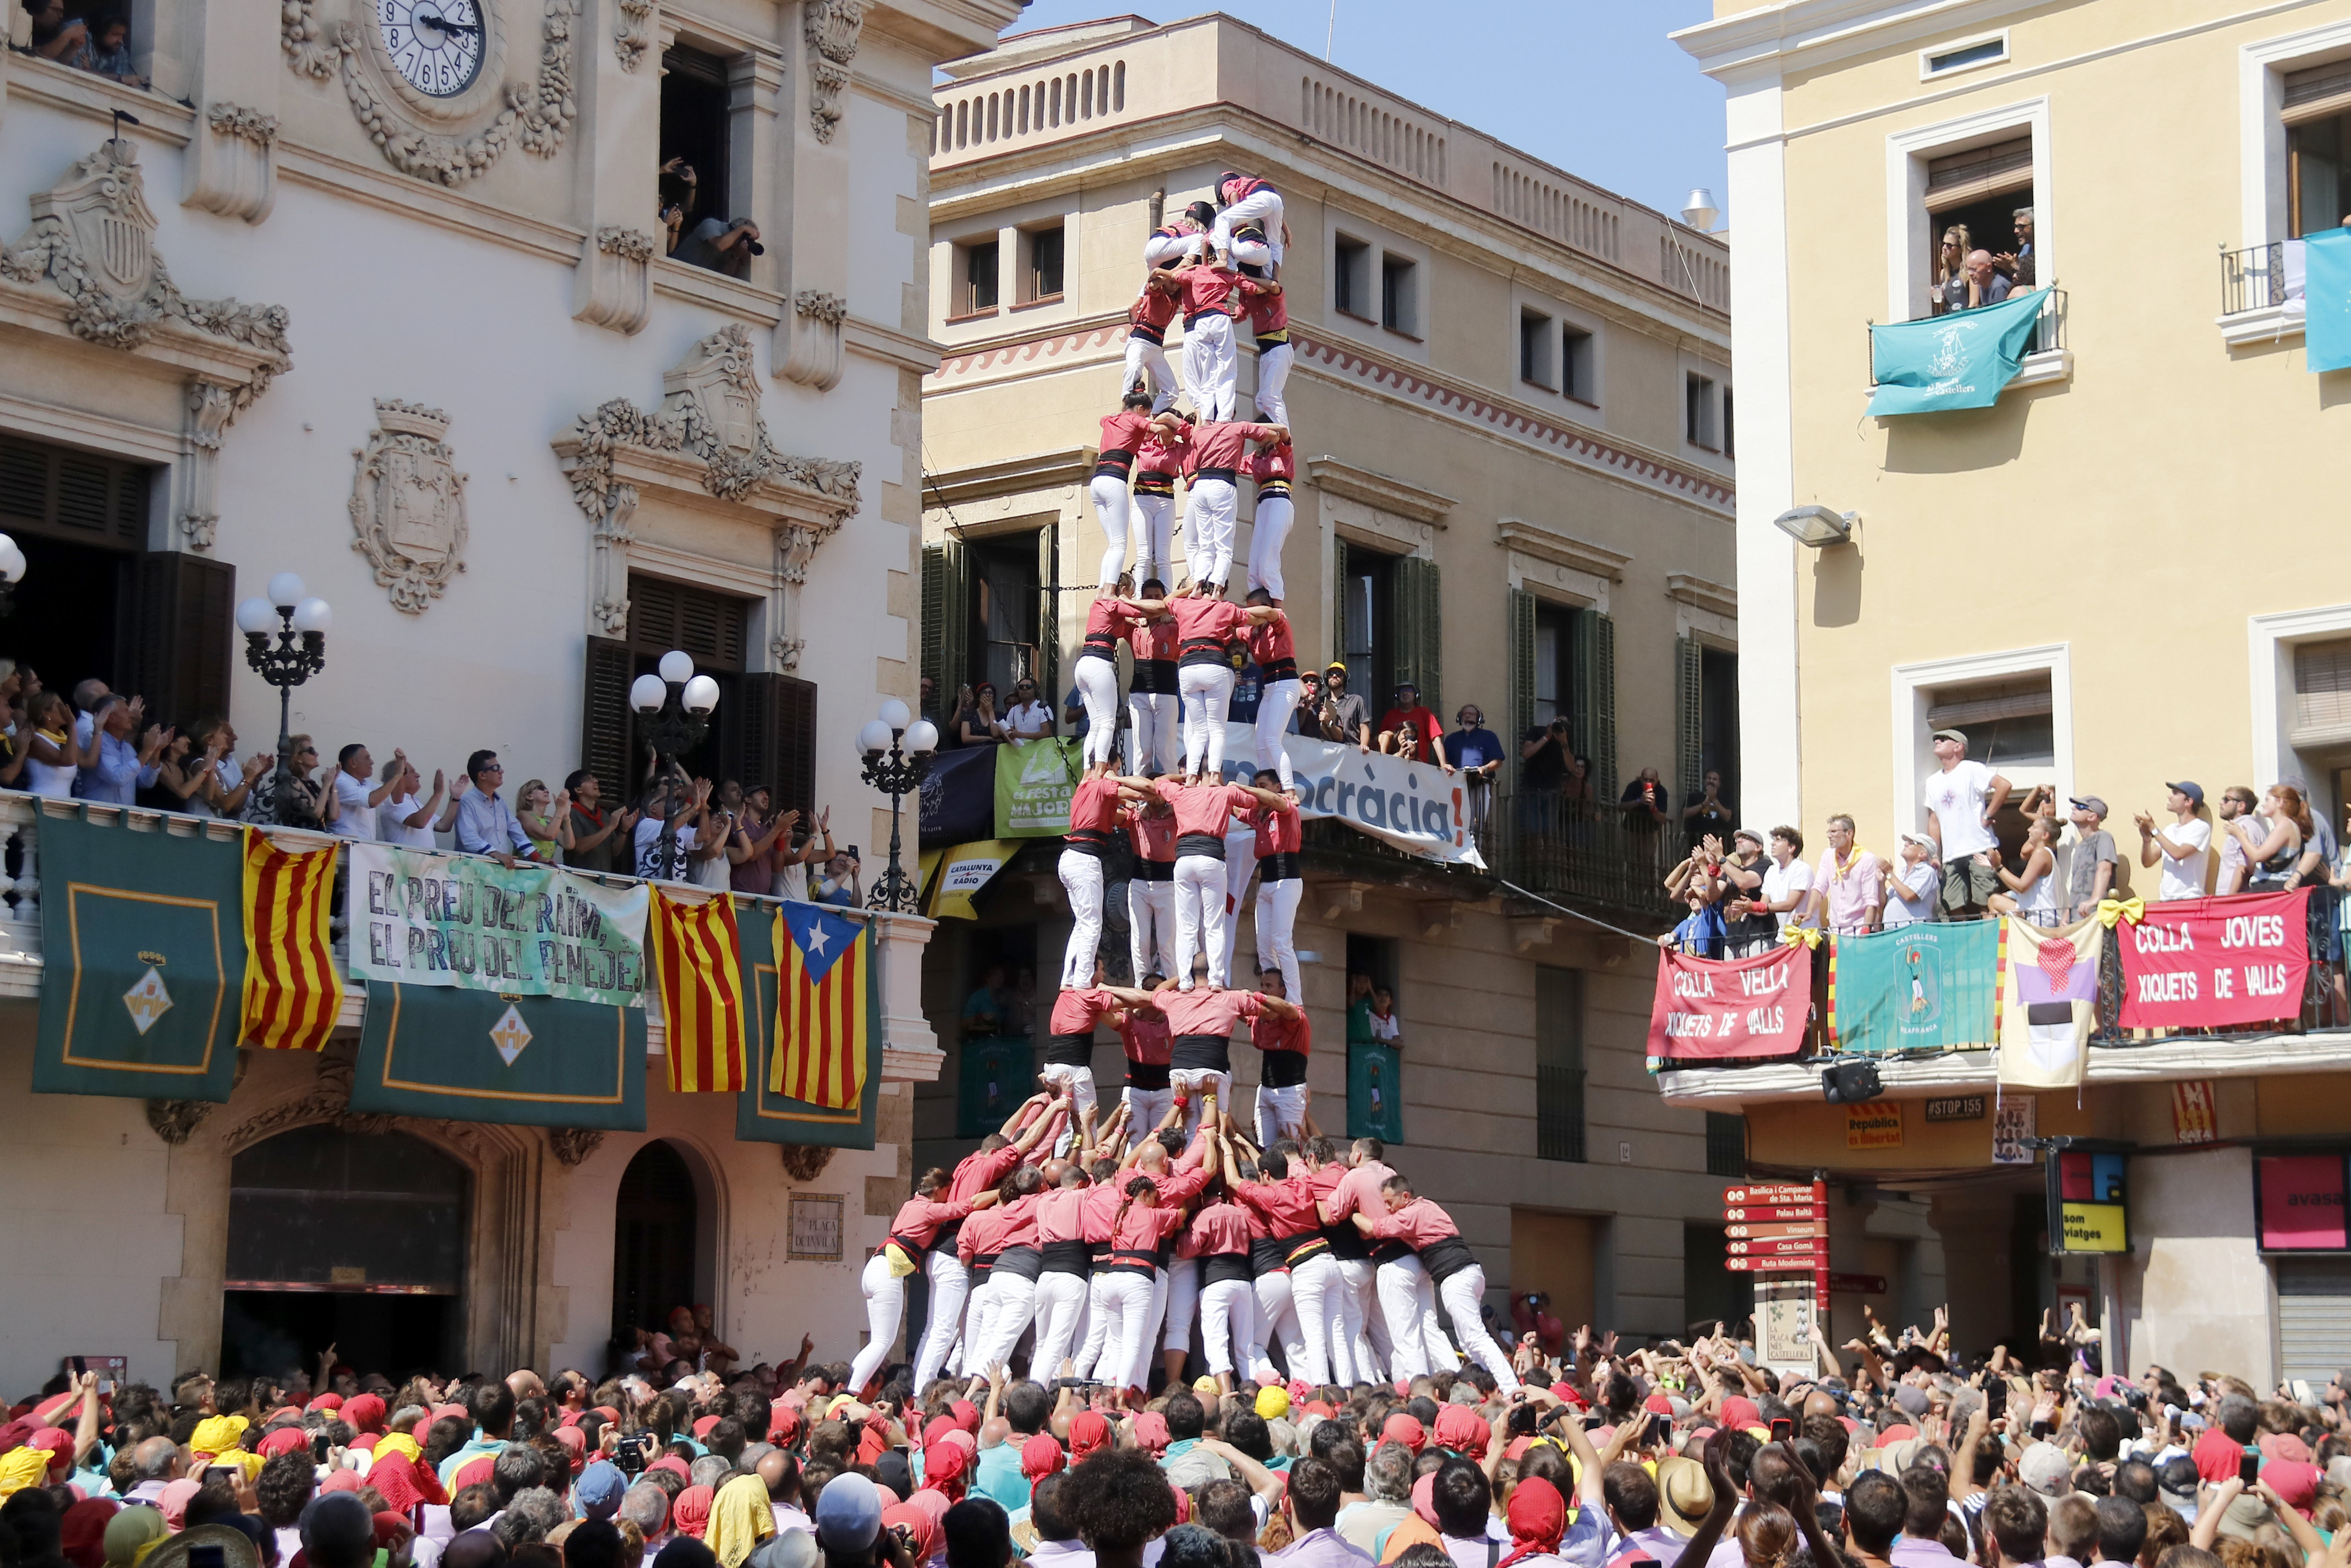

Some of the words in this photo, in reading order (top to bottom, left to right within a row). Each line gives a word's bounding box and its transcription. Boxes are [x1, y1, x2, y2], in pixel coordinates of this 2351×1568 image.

[386, 2, 395, 22] 9
[457, 2, 465, 23] 2
[390, 28, 398, 48] 8
[406, 52, 414, 73] 7
[455, 51, 461, 72] 4
[423, 64, 431, 84] 6
[441, 65, 449, 85] 5
[1936, 385, 1975, 395] Castellers
[951, 864, 993, 873] CATALUNYA
[369, 871, 398, 917] EL
[407, 877, 473, 925] PREU
[483, 886, 528, 932] DEL
[536, 886, 607, 947] RAÏM,
[1896, 933, 1938, 946] CASTELLERS
[2135, 921, 2194, 954] COLLA
[2220, 915, 2283, 948] JOVES
[369, 921, 401, 969] EL
[408, 927, 477, 975] PREU
[483, 935, 533, 980] DEL
[539, 939, 643, 993] PENEDÈS
[1674, 970, 1715, 998] COLLA
[1739, 963, 1789, 996] VELLA
[2138, 971, 2197, 1003] XIQUETS
[2215, 968, 2233, 999] DE
[2244, 963, 2286, 997] VALLS
[1665, 1012, 1713, 1037] XIQUETS
[1717, 1013, 1738, 1037] DE
[1747, 1006, 1784, 1035] VALLS
[1900, 1023, 1937, 1034] VILAFRANCA
[1928, 1100, 1961, 1115] #STOP
[1964, 1099, 1982, 1113] 155
[1749, 1187, 1773, 1195] Basílica
[2288, 1193, 2344, 1206] avasa
[2064, 1215, 2085, 1223] som
[2064, 1226, 2101, 1241] viatges
[1794, 1241, 1813, 1249] Gomà
[1778, 1258, 1815, 1266] Modernista
